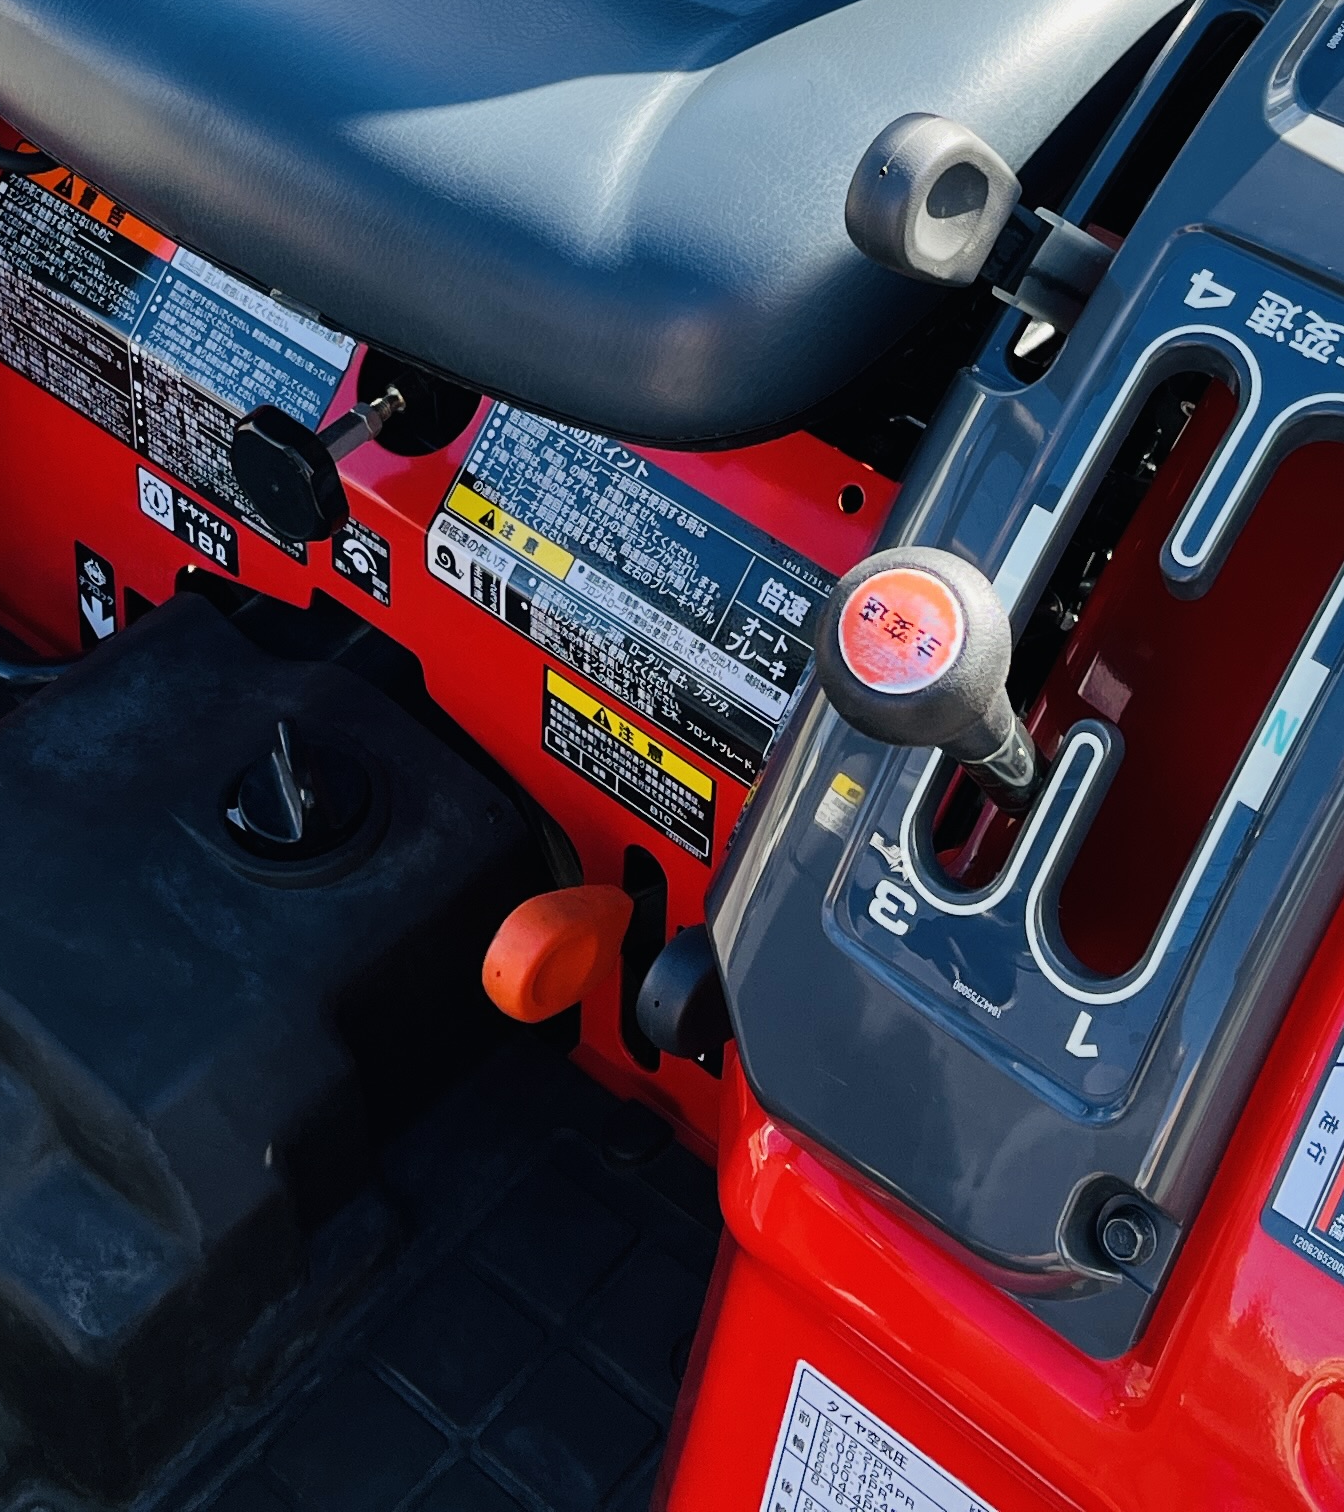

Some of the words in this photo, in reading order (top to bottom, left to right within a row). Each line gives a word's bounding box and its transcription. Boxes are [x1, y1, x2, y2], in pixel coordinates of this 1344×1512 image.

[1183, 269, 1236, 309] 4
[177, 494, 231, 544] ギヤオイル
[498, 518, 540, 557] 注意
[755, 574, 812, 628] 倍速
[739, 613, 793, 660] オート
[857, 594, 937, 662] 主変速
[722, 629, 790, 685] ブレーキ
[1260, 707, 1302, 759] N
[867, 879, 918, 936] 3
[1065, 1010, 1099, 1058] 1
[1302, 1108, 1342, 1167] 走行
[825, 1397, 909, 1472] タイヤ空気圧
